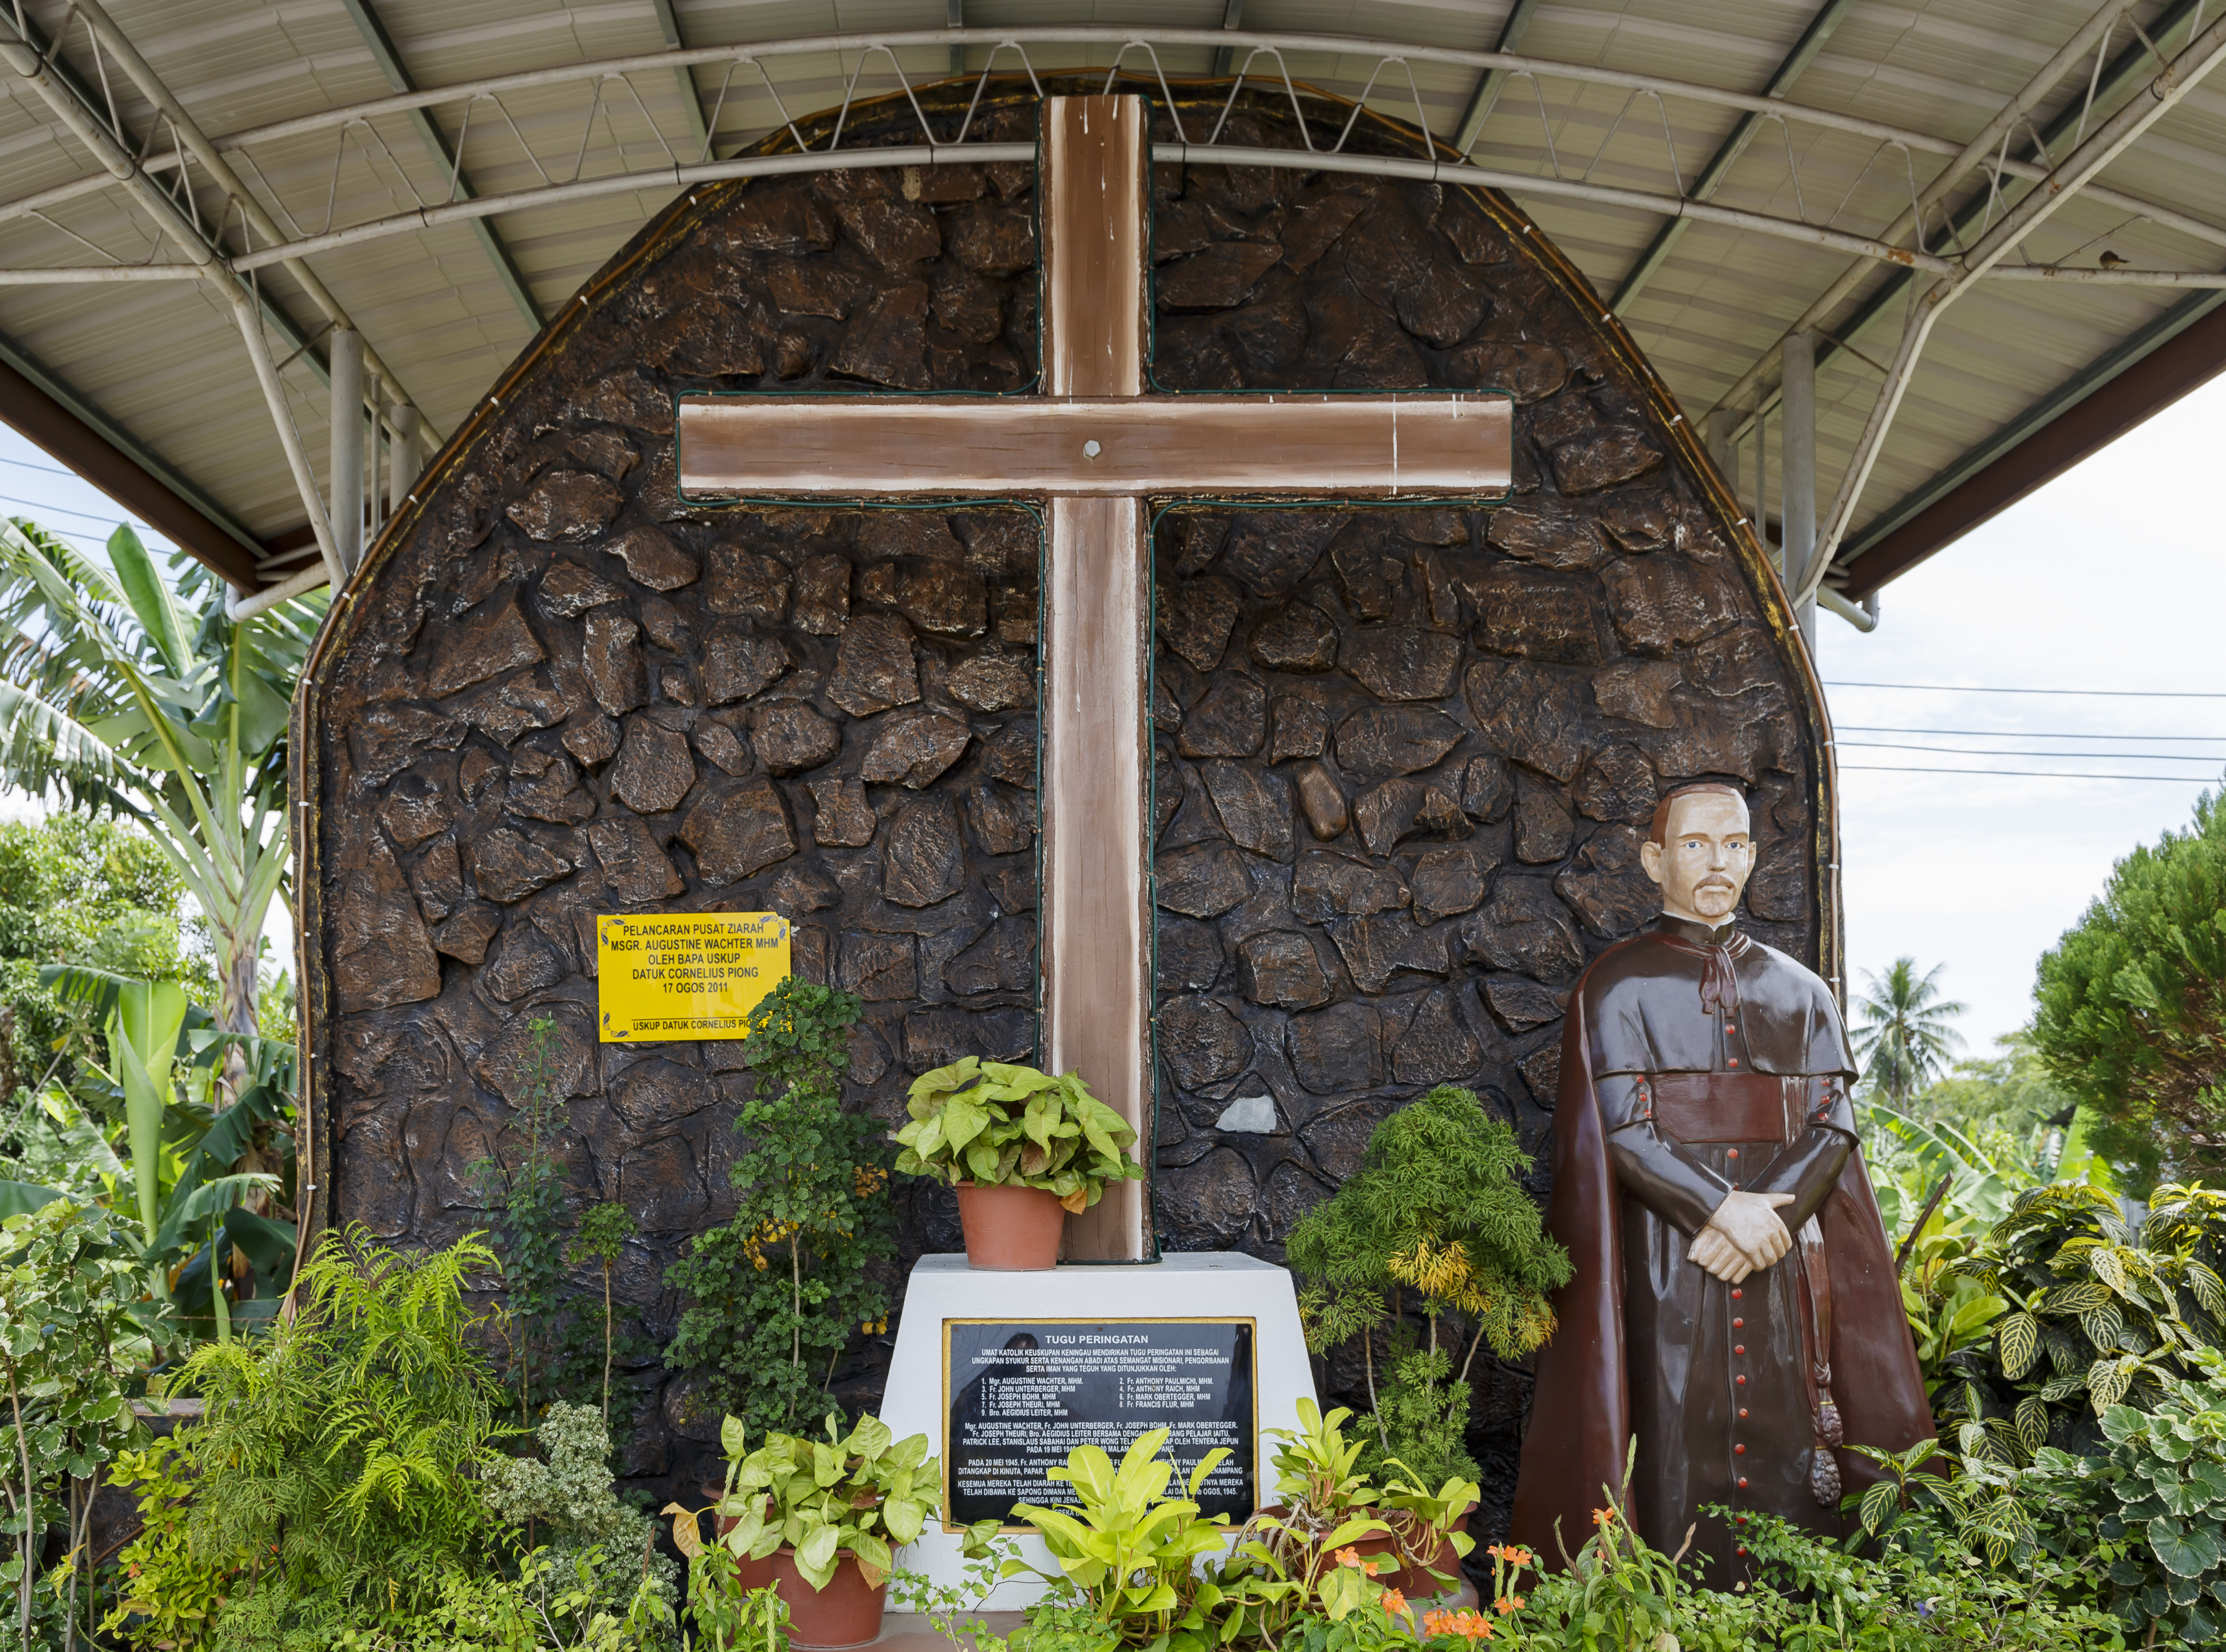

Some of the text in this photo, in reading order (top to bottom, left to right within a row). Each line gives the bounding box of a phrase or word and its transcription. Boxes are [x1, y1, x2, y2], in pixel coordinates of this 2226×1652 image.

[623, 922, 764, 936] PELANCARAN PUSAT ZIARAH
[611, 937, 778, 951] MSGR. AUGUSTINE WACHTER MHM
[648, 953, 740, 965] OLEH BAPA USKUP
[632, 967, 758, 980] DATUK CORNELIUS PIONG
[663, 982, 727, 993] 17 OGOS 2011
[633, 1019, 736, 1031] USKUP DATUK CORNELIUS
[1045, 1335, 1148, 1344] TUGU PERINGATAN
[1130, 1348, 1146, 1356] TUGU
[1147, 1348, 1183, 1356] PERINGATAN
[1193, 1348, 1219, 1356] SEBAGAI
[1119, 1356, 1151, 1364] SEMANGAT
[1152, 1357, 1184, 1365] MISIONARI,
[1025, 1365, 1045, 1373] SERTA
[1159, 1364, 1177, 1372] OLEH:
[989, 1377, 1001, 1387] Mgr.
[1002, 1377, 1036, 1385] AUGUSTINE
[1036, 1377, 1067, 1385] WACHTER,
[1068, 1377, 1084, 1385] MHM.
[1119, 1377, 1124, 1385] 2.
[1127, 1377, 1135, 1385] Fr.
[1165, 1377, 1198, 1386] PAULMICHI,
[1015, 1385, 1061, 1393] UNTERBERGER,
[1127, 1385, 1135, 1393] Fr.
[1165, 1385, 1185, 1393] RAICH,
[1021, 1393, 1041, 1401] BOHM,
[1127, 1393, 1135, 1401] Fr.
[1135, 1393, 1153, 1401] MARK
[1154, 1393, 1195, 1401] OBERTEGGER,
[1021, 1401, 1045, 1409] THEURI,
[1046, 1400, 1060, 1408] MHM
[1135, 1400, 1161, 1408] FRANCIS
[1162, 1400, 1179, 1409] FLUR,
[1001, 1408, 1030, 1416] AEGIDIUS
[1031, 1409, 1053, 1417] LEITER,
[965, 1422, 977, 1432] Mgr.
[978, 1422, 1012, 1430] AUGUSTINE
[1012, 1422, 1044, 1431] WACHTER,
[1070, 1421, 1115, 1430] UNTERBERGER,
[1116, 1421, 1124, 1429] Fr.
[1124, 1421, 1148, 1429] JOSEPH
[1169, 1421, 1177, 1429] Fr.
[1005, 1430, 1028, 1439] THEURI,
[1041, 1429, 1070, 1437] AEGIDIUS
[1071, 1429, 1092, 1437] LEITER
[1092, 1429, 1122, 1437] BERSAMA
[1186, 1429, 1212, 1437] PELAJAR
[1213, 1429, 1230, 1438] IAITU,
[988, 1438, 1001, 1447] LEE,
[1002, 1437, 1039, 1445] STANISLAUS
[1039, 1437, 1066, 1445] SABAHAI
[1066, 1437, 1079, 1445] DAN
[1080, 1437, 1099, 1445] PETER
[1100, 1437, 1119, 1445] WONG
[1219, 1437, 1239, 1445] JEPUN
[1026, 1445, 1043, 1453] PADA
[968, 1459, 985, 1467] PADA
[985, 1459, 992, 1467] 20
[1005, 1459, 1020, 1467] 1945,
[992, 1467, 999, 1475] DI
[1000, 1467, 1023, 1476] KINUTA,
[957, 1480, 986, 1488] KESEMUA
[1012, 1479, 1032, 1487] TELAH
[1032, 1479, 1055, 1487] DIARAH
[1056, 1479, 1064, 1487] KE
[963, 1488, 983, 1496] TELAH
[983, 1488, 1007, 1496] DIBAWA
[1007, 1488, 1016, 1496] KE
[1017, 1488, 1042, 1496] SAPONG
[1203, 1487, 1222, 1496] OGOS,
[1018, 1496, 1049, 1504] SEHINGGA
